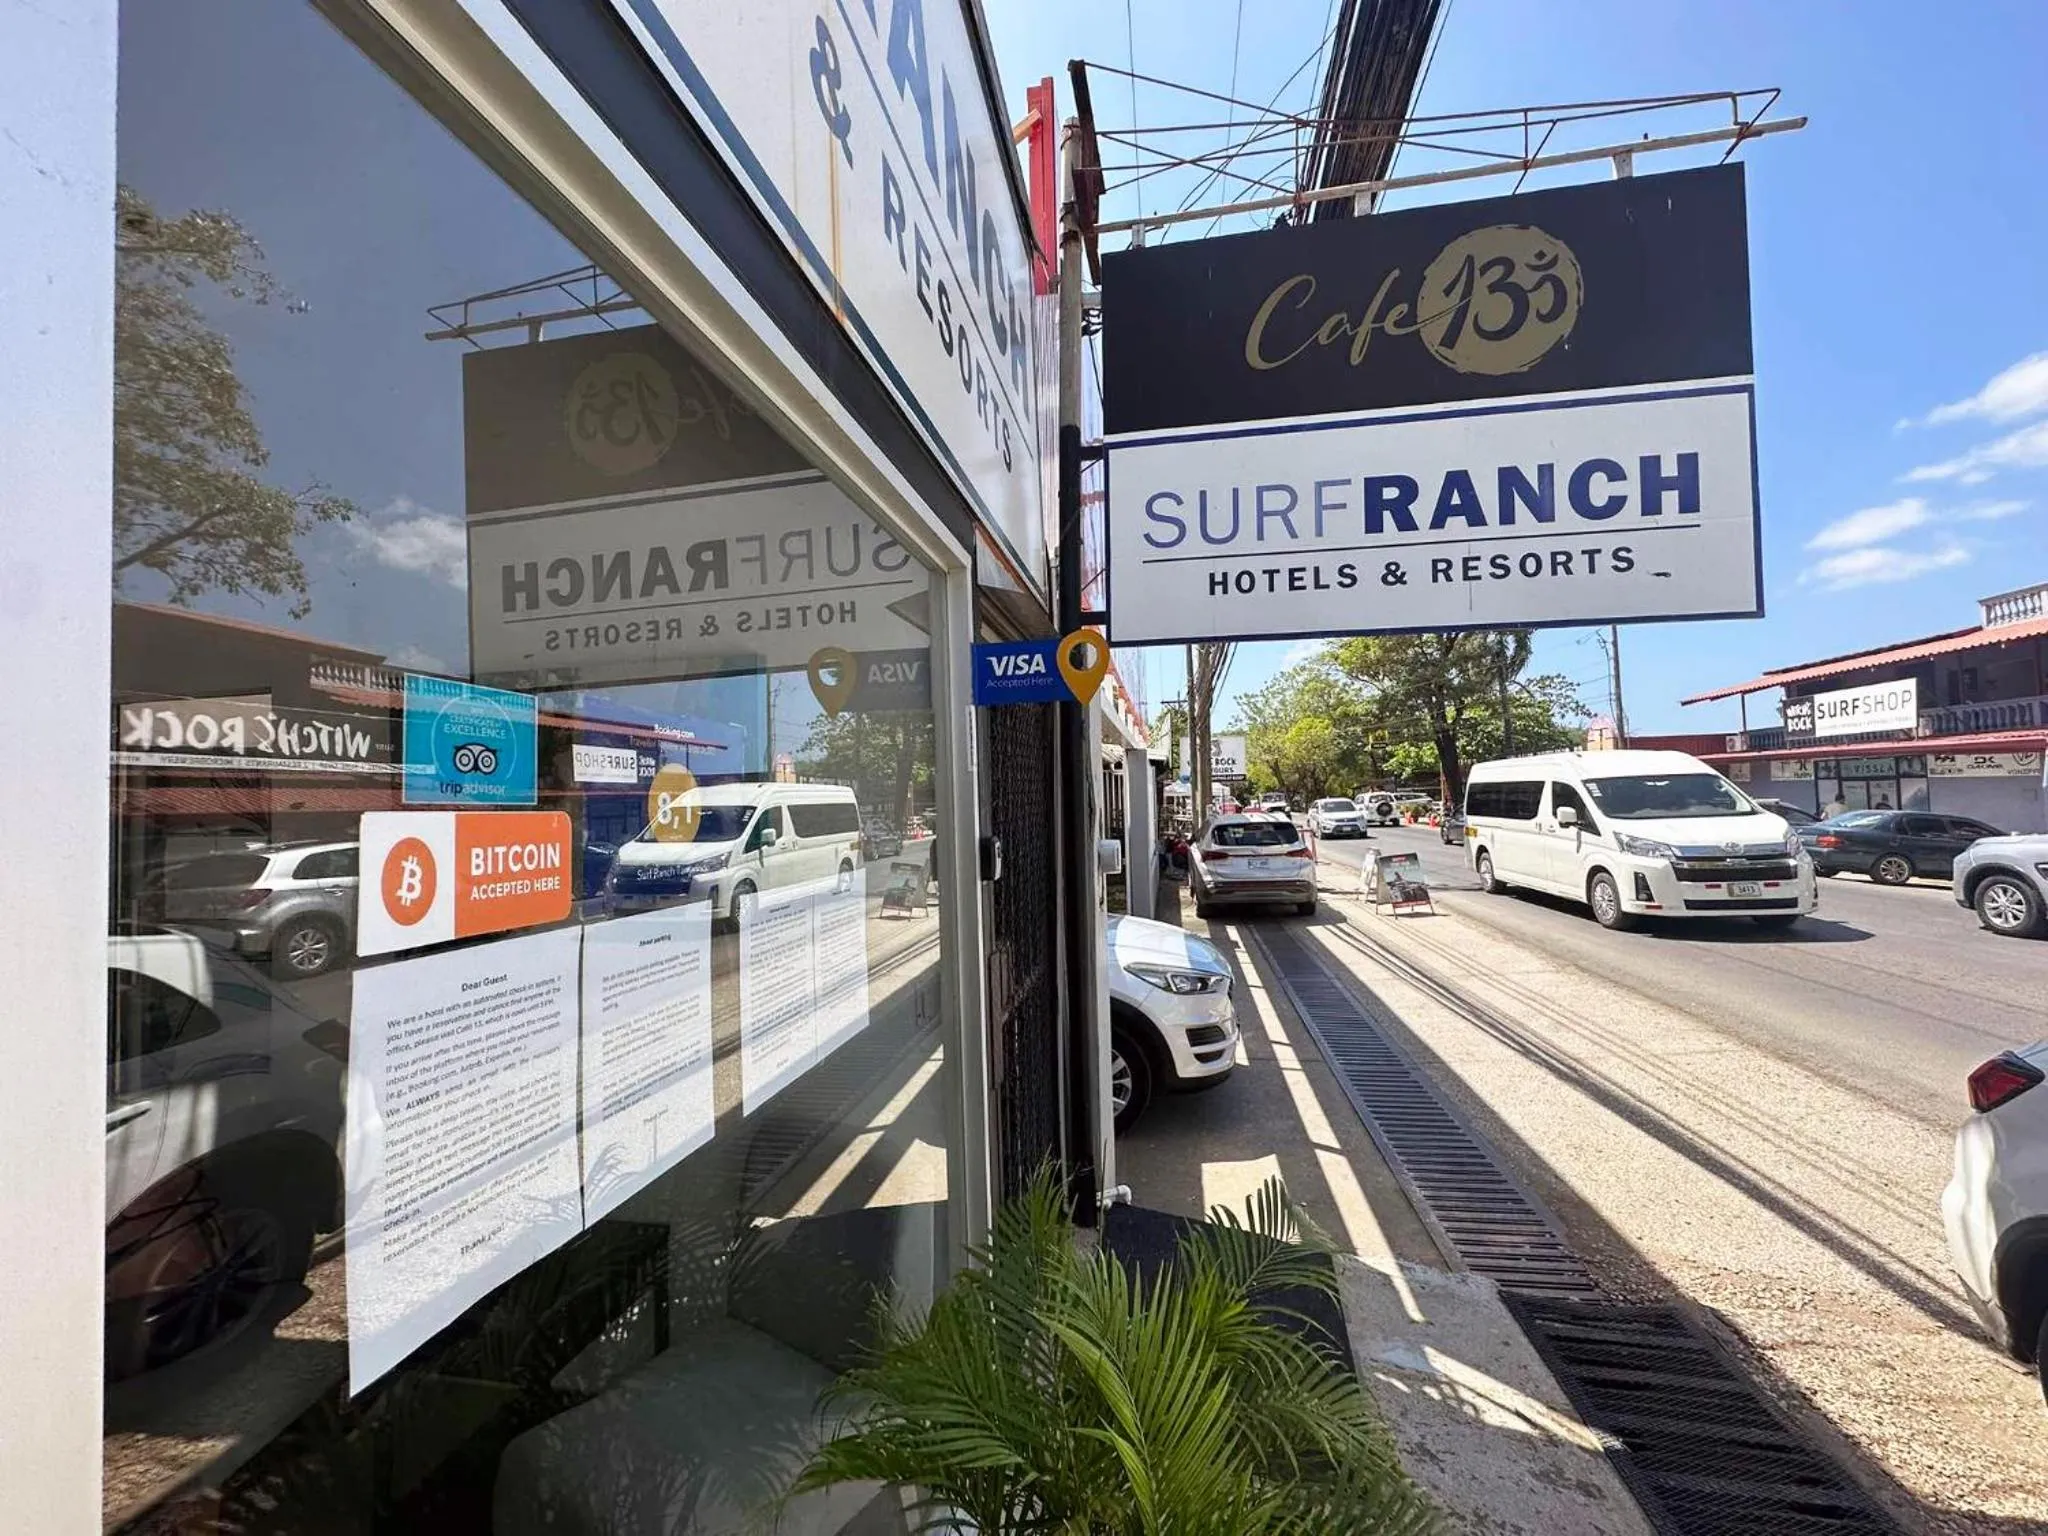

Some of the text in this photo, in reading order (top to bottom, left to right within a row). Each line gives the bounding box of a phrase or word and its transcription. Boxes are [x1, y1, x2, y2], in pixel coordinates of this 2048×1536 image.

[861, 0, 1029, 423] ANCH
[881, 150, 1012, 472] RESORTS
[1244, 267, 1424, 372] Cafe
[1208, 546, 1635, 597] HOTELS & RESORTS
[986, 653, 1046, 676] VISA
[985, 675, 1054, 688] Accepted Here
[443, 723, 507, 740] EXCELLENCE
[1787, 716, 1813, 733] ROCK
[439, 780, 506, 798] tripadvisor
[470, 842, 561, 876] BITCOIN
[470, 876, 561, 901] ACCEPTED HERE
